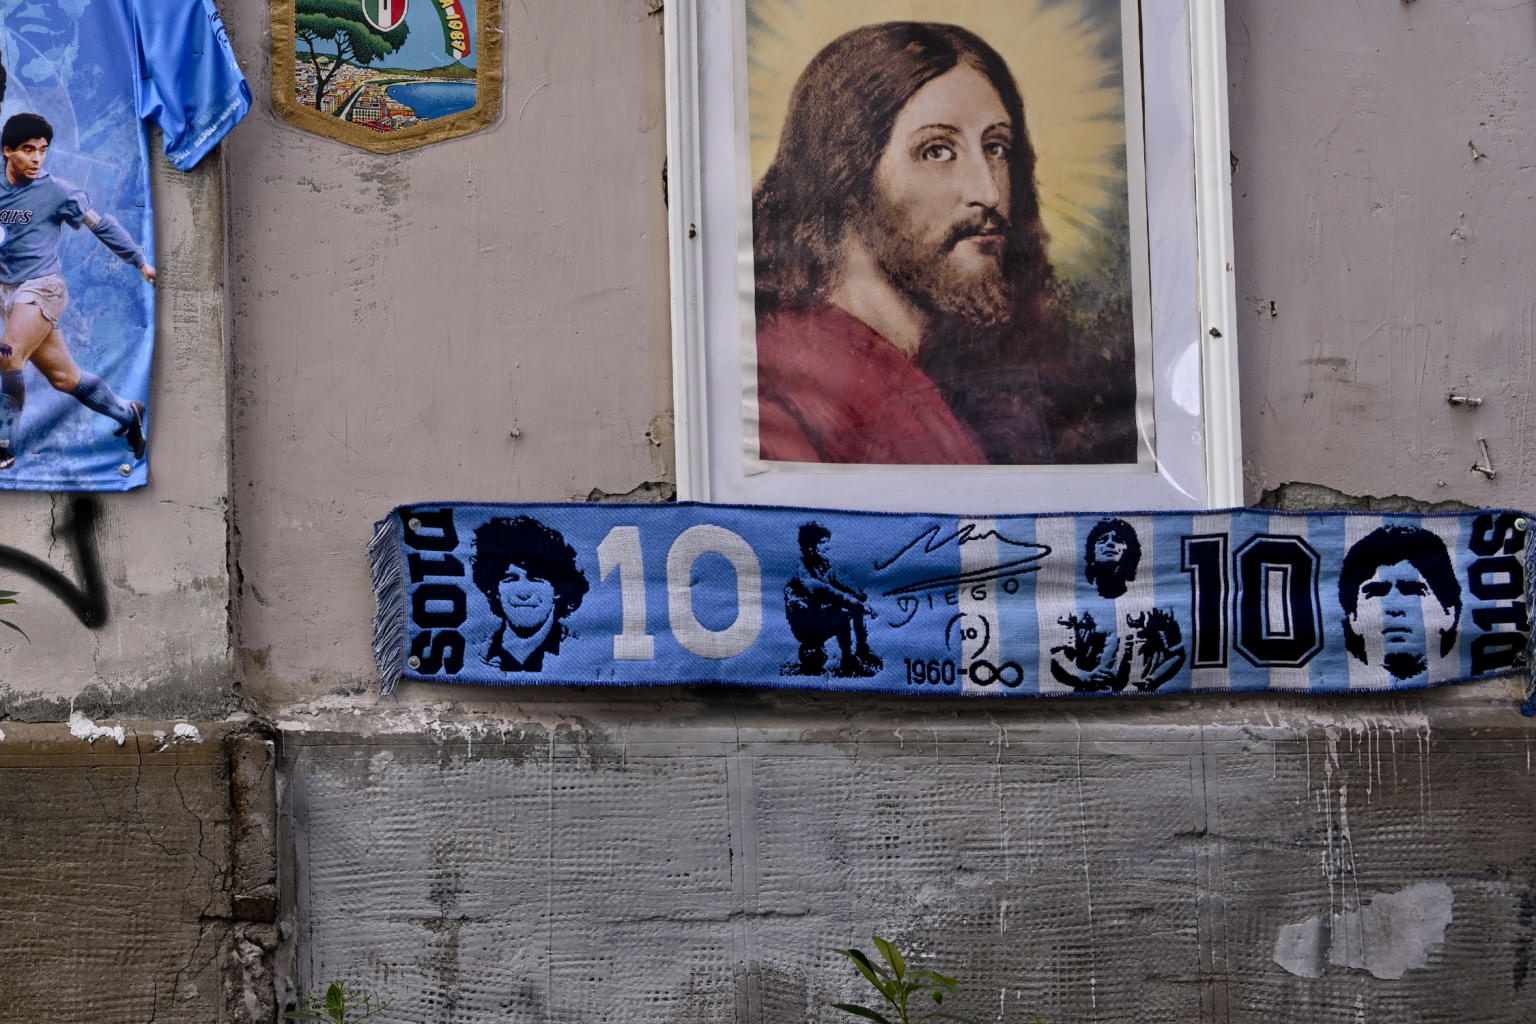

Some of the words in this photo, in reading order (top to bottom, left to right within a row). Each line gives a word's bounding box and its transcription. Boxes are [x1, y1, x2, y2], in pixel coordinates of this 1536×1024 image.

[445, 13, 467, 53] 1987
[596, 523, 763, 660] 10
[1180, 533, 1322, 669] 10
